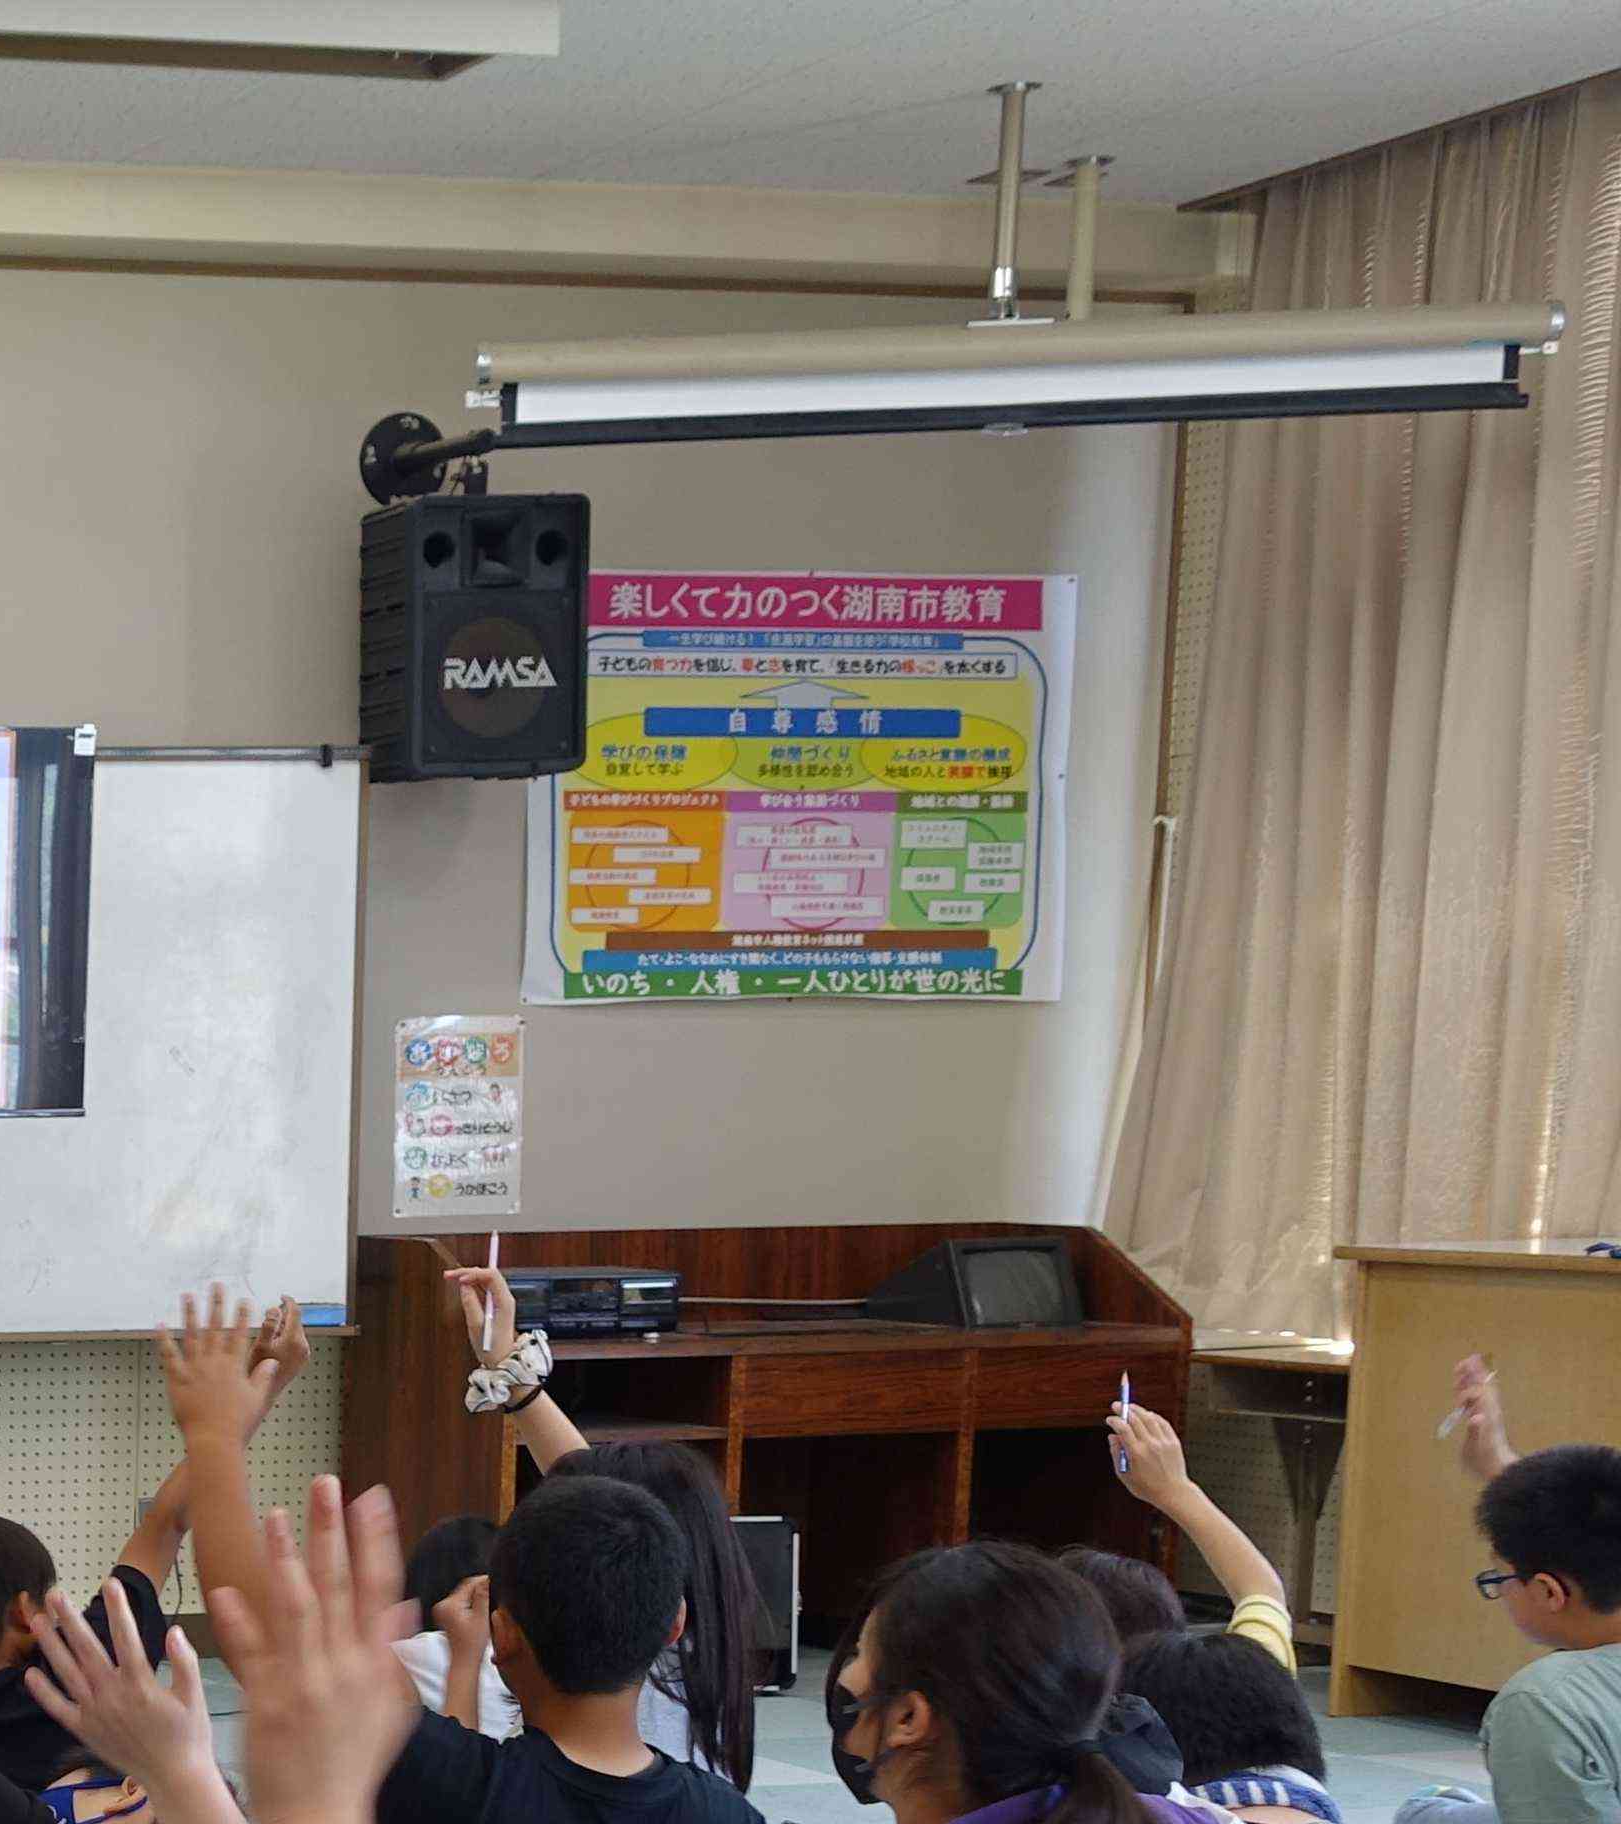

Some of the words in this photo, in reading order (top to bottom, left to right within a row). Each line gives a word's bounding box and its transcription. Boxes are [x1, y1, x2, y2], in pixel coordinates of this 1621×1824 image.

[609, 584, 1007, 624] 楽しくて力のつく湖南市教育
[443, 656, 557, 689] RAMSA
